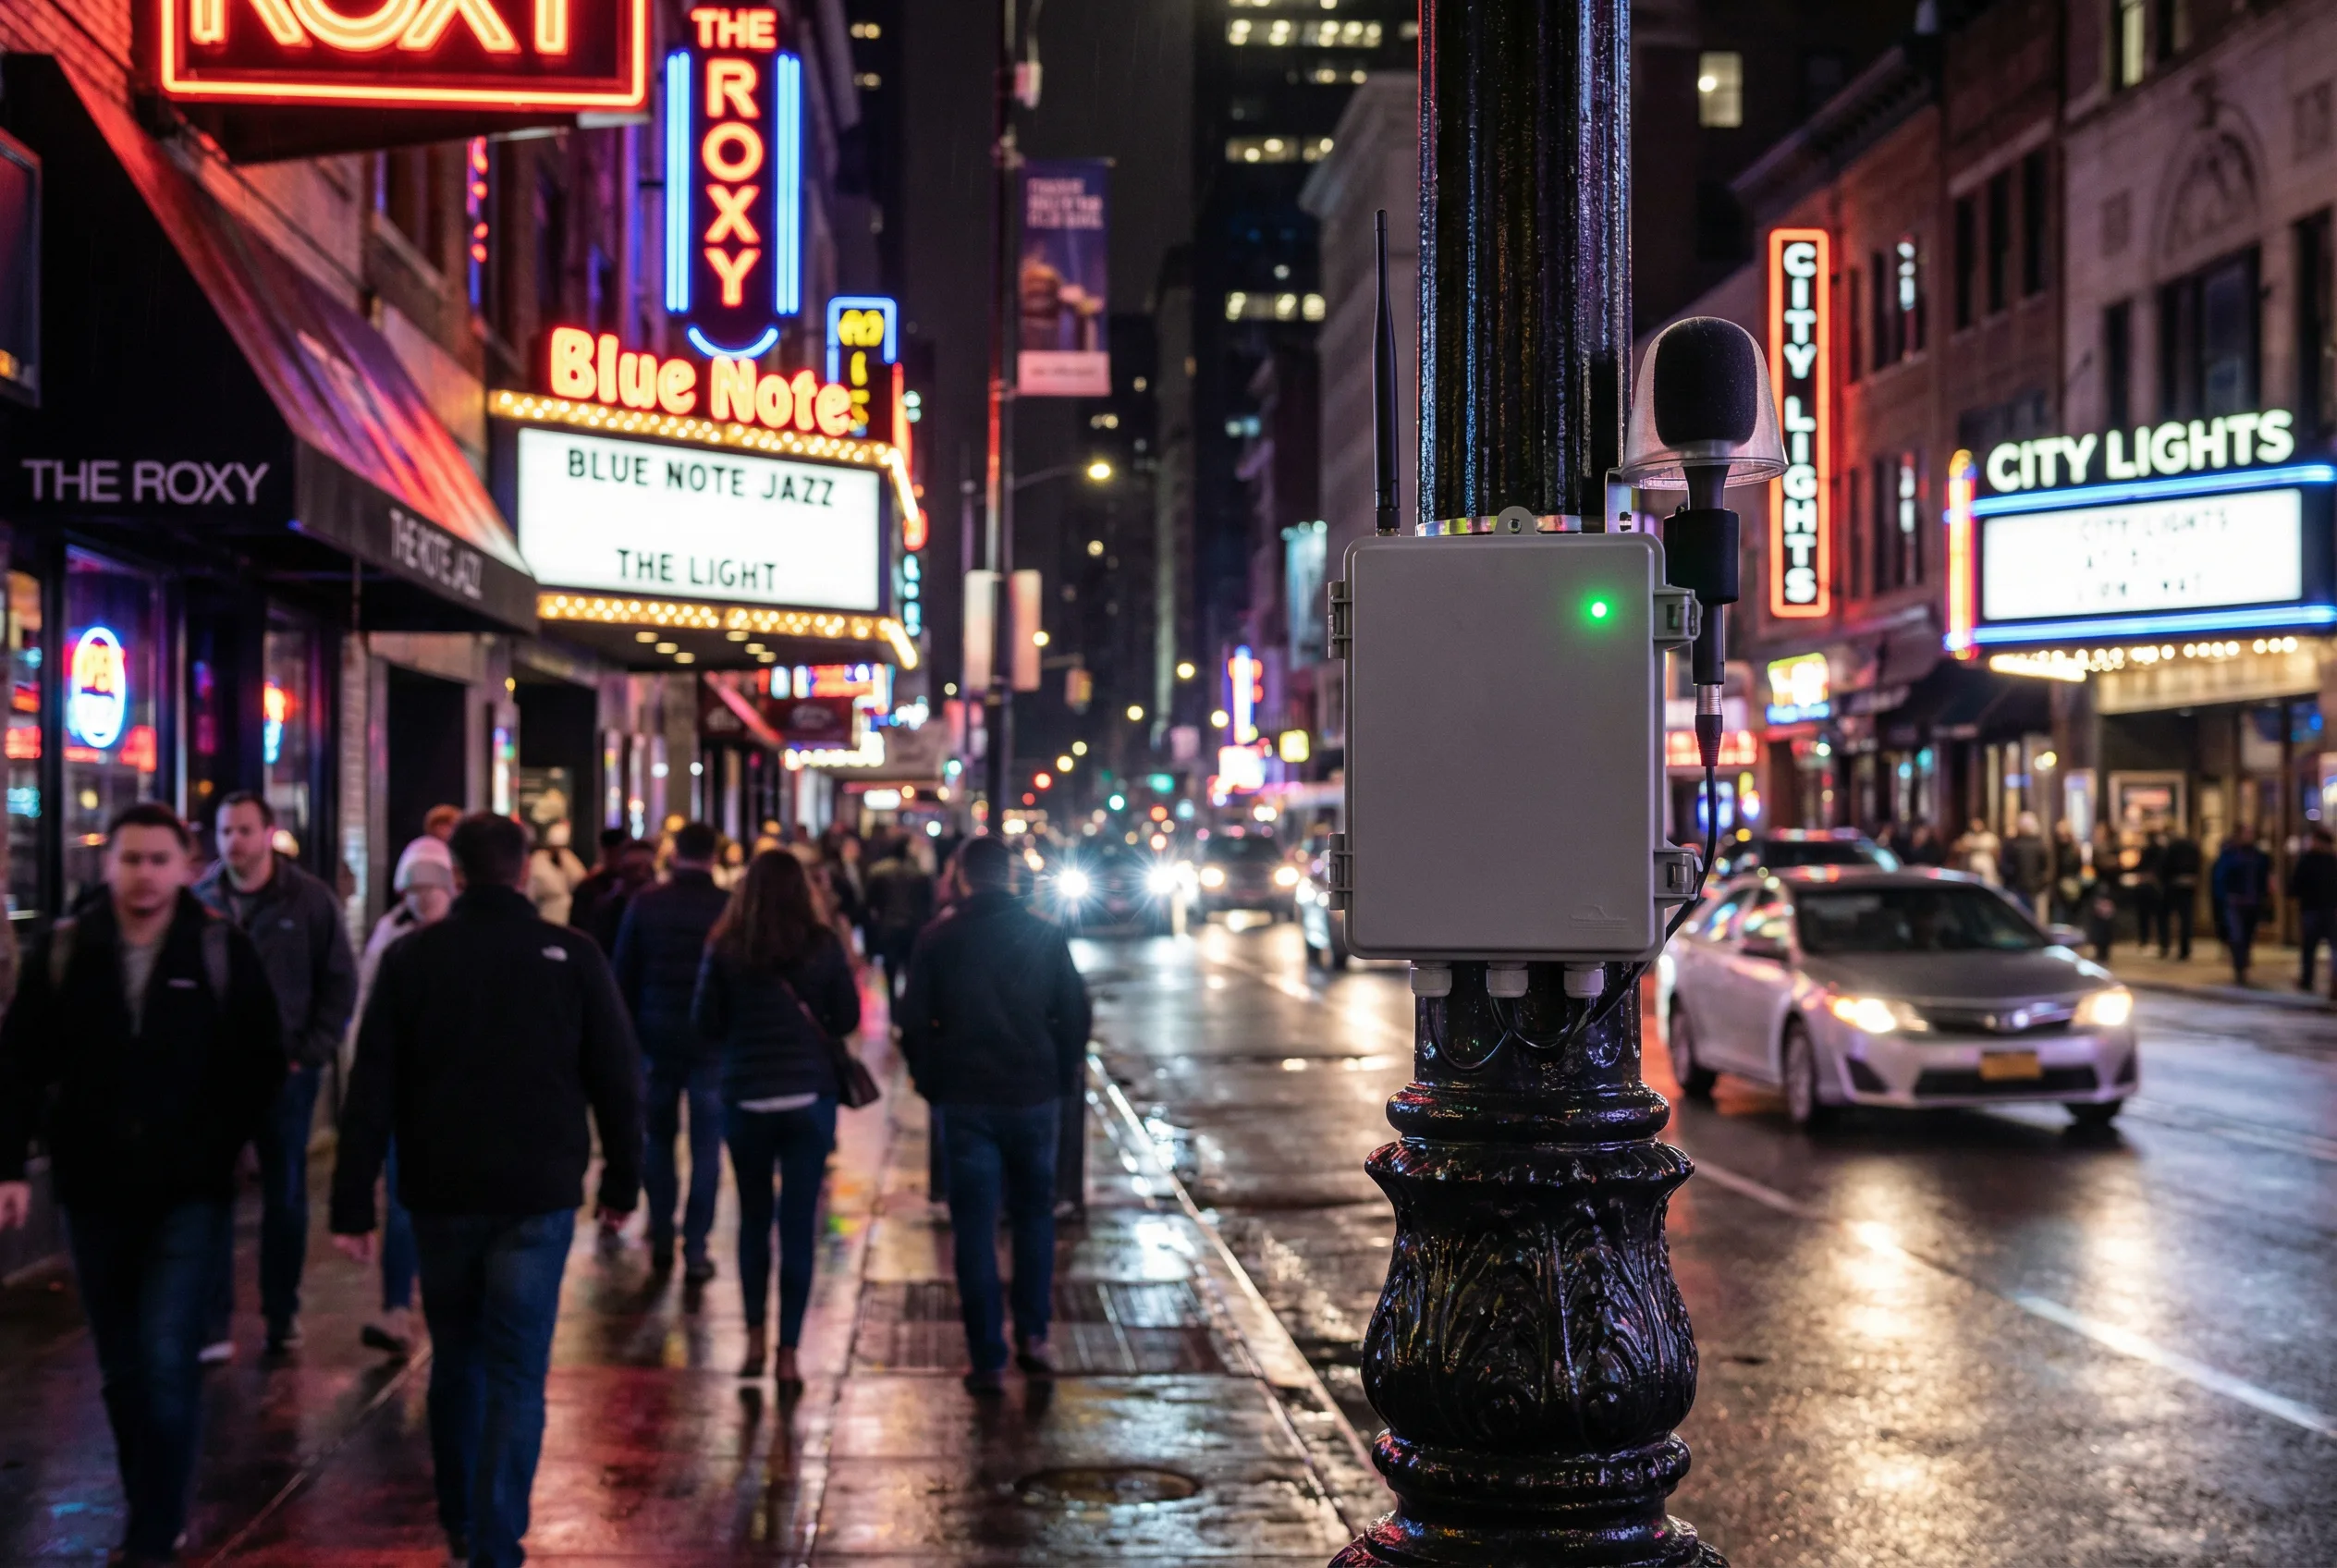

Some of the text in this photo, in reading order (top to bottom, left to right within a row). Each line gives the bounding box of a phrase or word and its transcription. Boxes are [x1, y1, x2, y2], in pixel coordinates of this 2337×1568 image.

[691, 8, 777, 50] THE
[702, 57, 764, 308] ROXY
[551, 326, 697, 415] Blue
[711, 355, 852, 436] Note
[1782, 242, 1818, 604] CITY LIGHTS
[1987, 409, 2295, 493] CITY LIGHTS
[21, 459, 270, 505] THE ROXY
[568, 448, 836, 508] BLUE NOTE JAZZ
[617, 549, 778, 592] THE LIGHT
